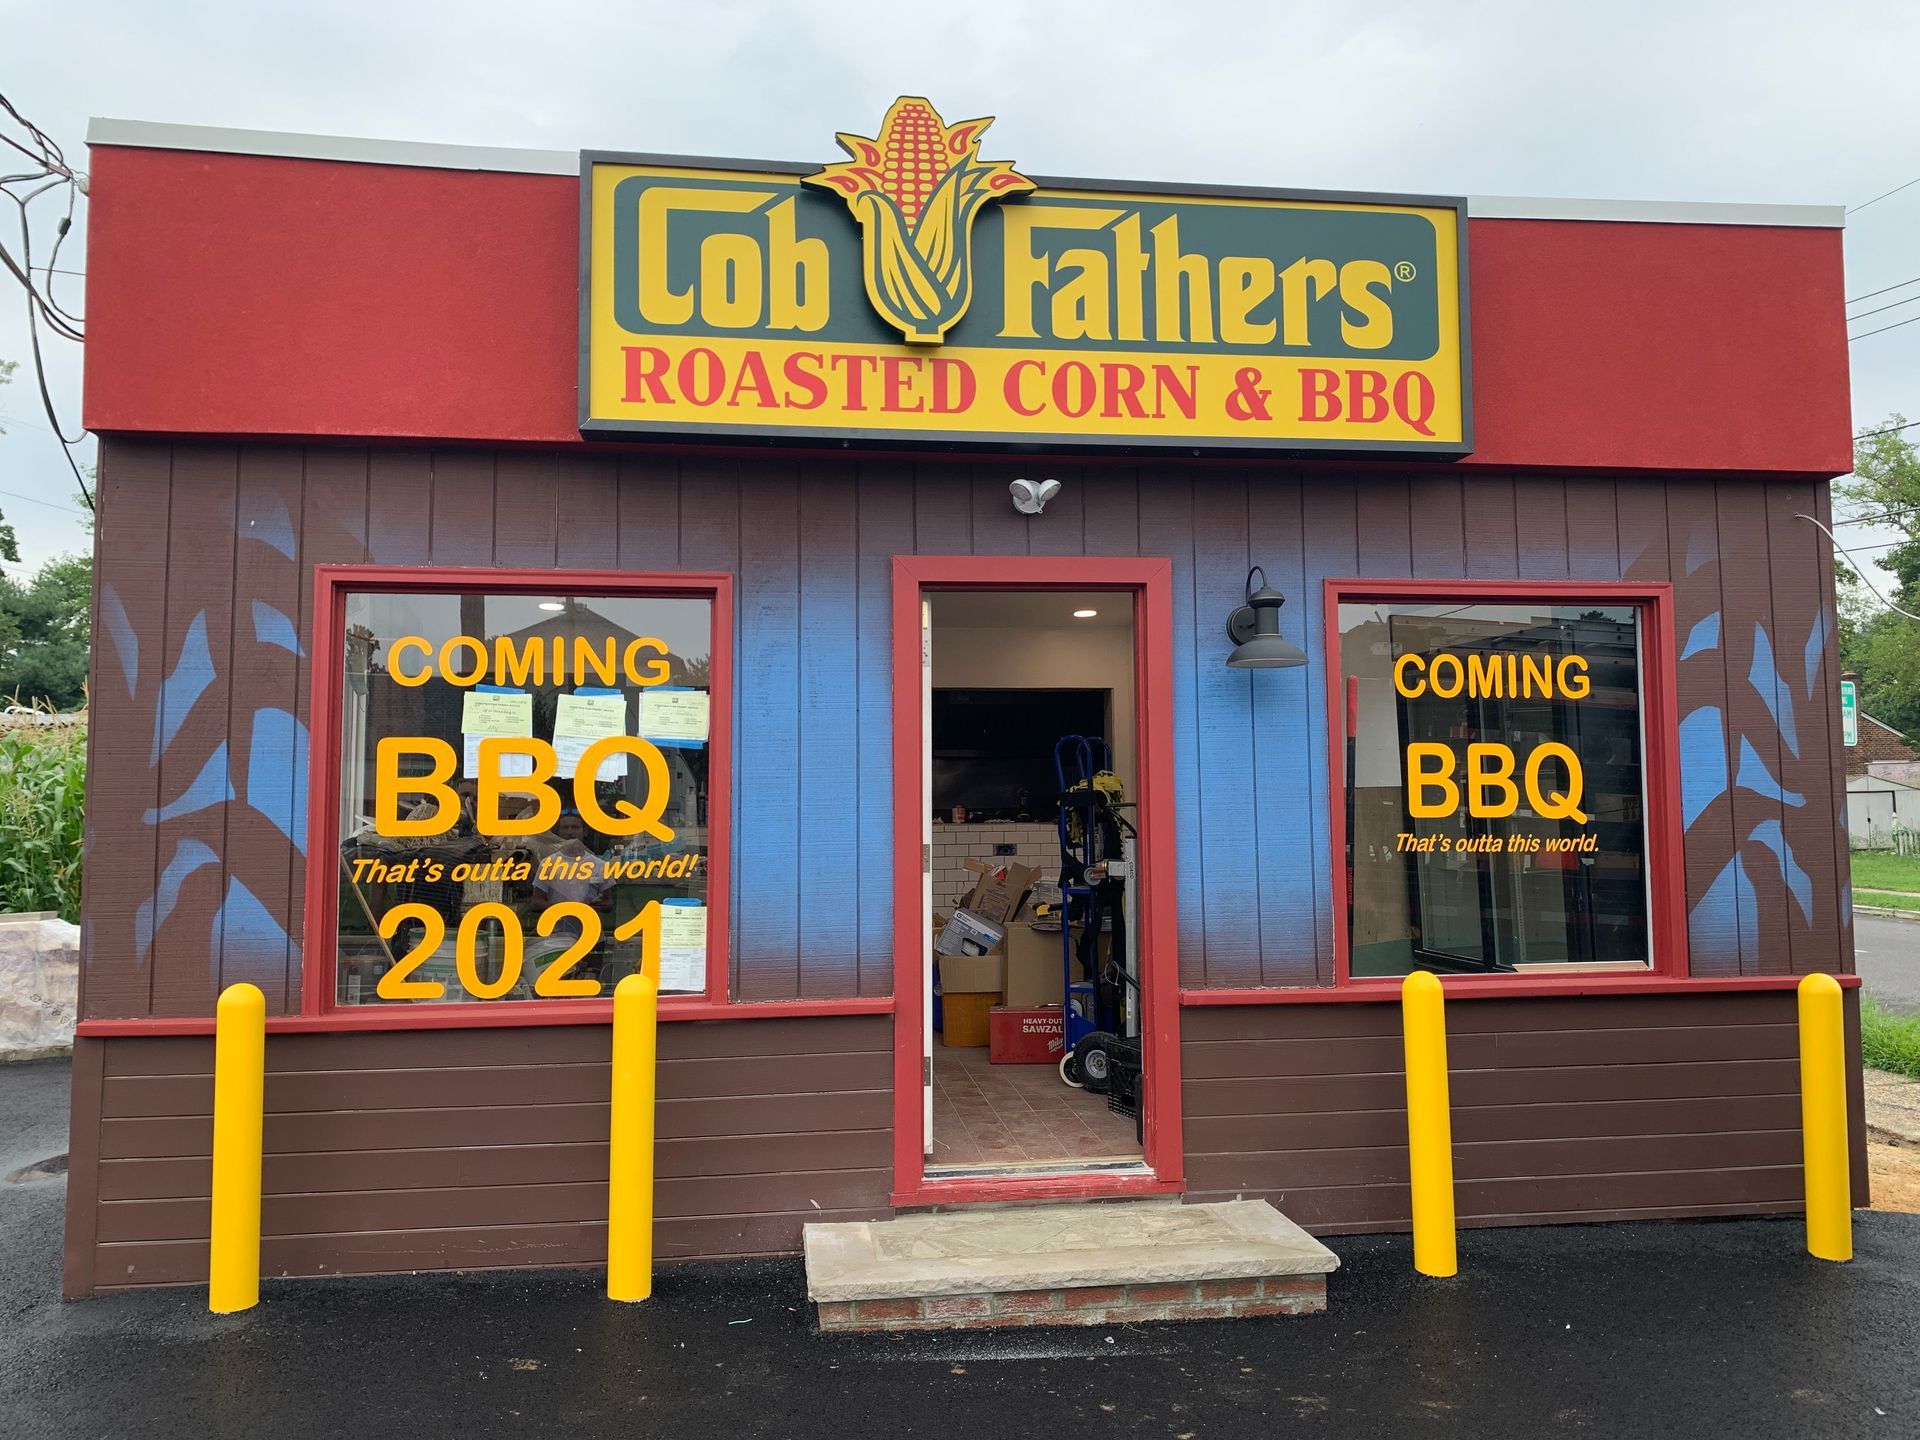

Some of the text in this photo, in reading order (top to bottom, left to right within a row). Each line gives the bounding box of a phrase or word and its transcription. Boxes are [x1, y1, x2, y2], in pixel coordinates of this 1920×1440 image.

[638, 186, 830, 332] Cob
[995, 204, 1394, 350] Fathers
[620, 345, 1436, 436] ROASTED CORN & BBQ
[387, 636, 671, 687] COMING
[1394, 654, 1590, 700] COMING
[374, 736, 676, 843] BBQ
[1406, 741, 1588, 825] BBQ
[351, 853, 699, 884] That’s outta this world!
[1396, 833, 1599, 853] That’s outta this world.
[376, 900, 662, 999] 2021
[1022, 1025, 1064, 1033] SAWZAL
